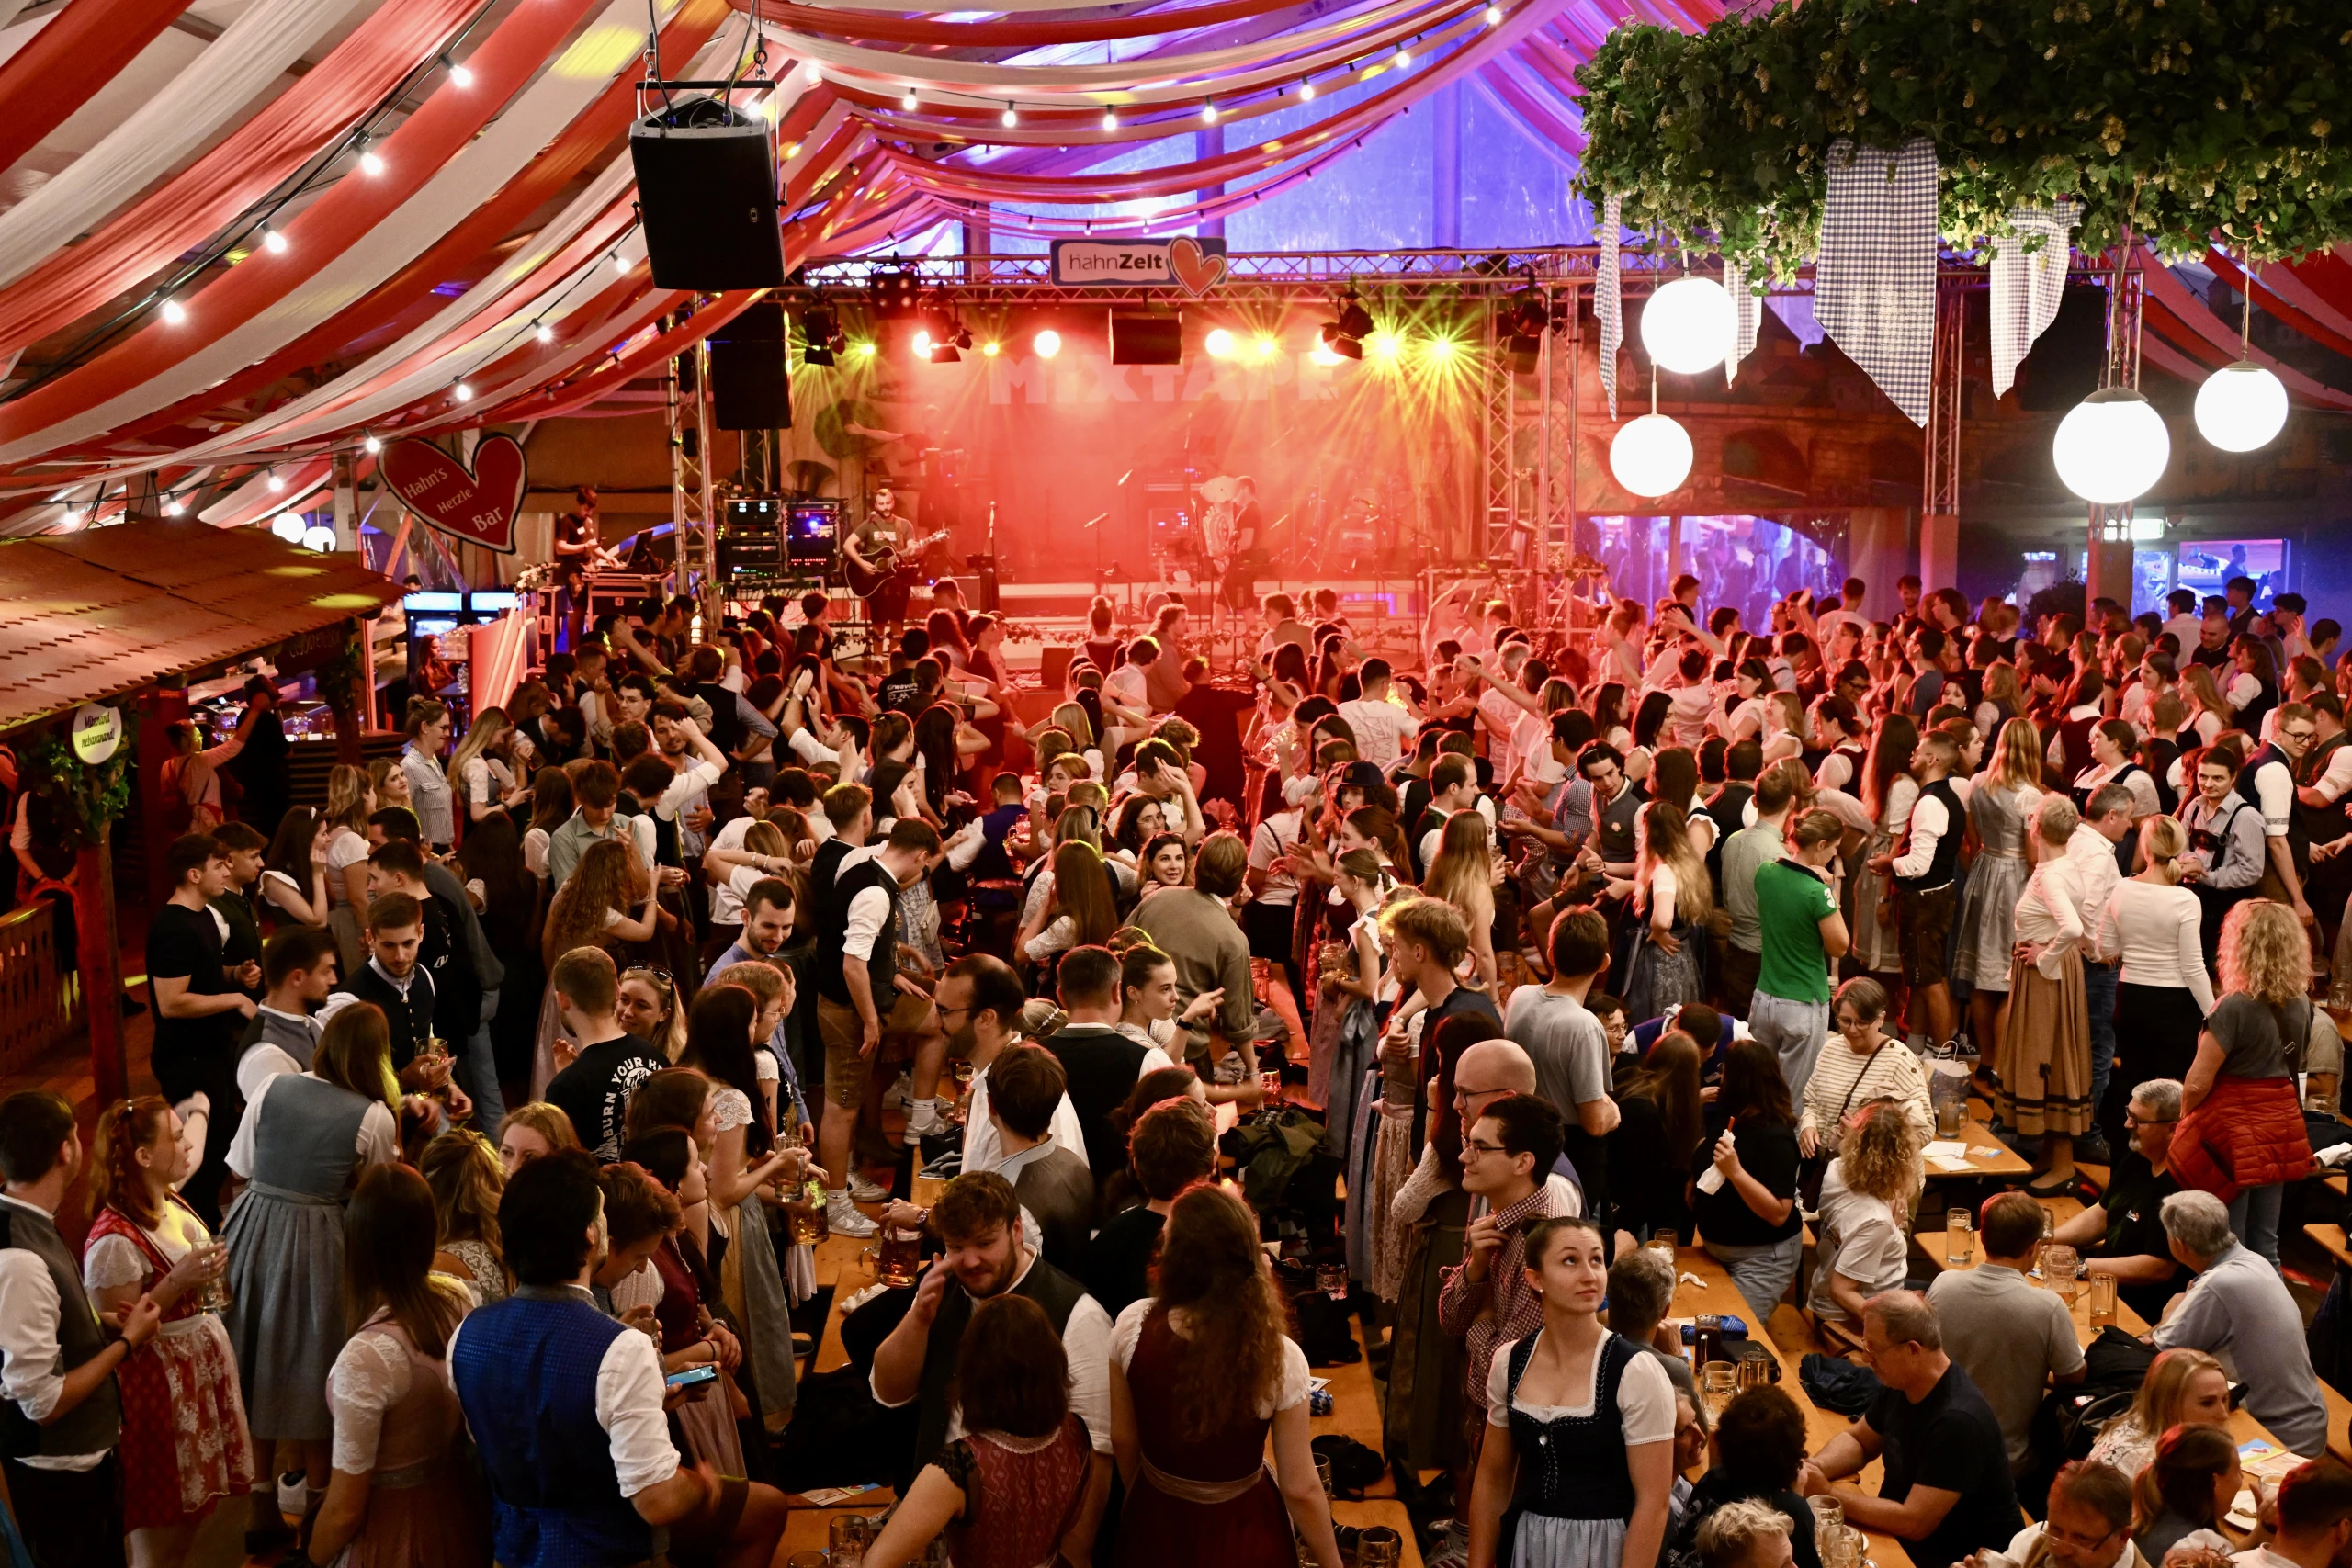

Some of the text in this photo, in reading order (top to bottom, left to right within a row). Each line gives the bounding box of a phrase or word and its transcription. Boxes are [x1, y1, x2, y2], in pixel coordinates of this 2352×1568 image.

[1069, 253, 1163, 270] hahnZelt
[988, 353, 1339, 405] MIXTAPE
[403, 467, 448, 500] Hahn's
[436, 487, 474, 514] Herzle
[471, 506, 503, 533] Bar
[602, 1091, 617, 1139] BURN
[611, 1056, 645, 1085] YOUR
